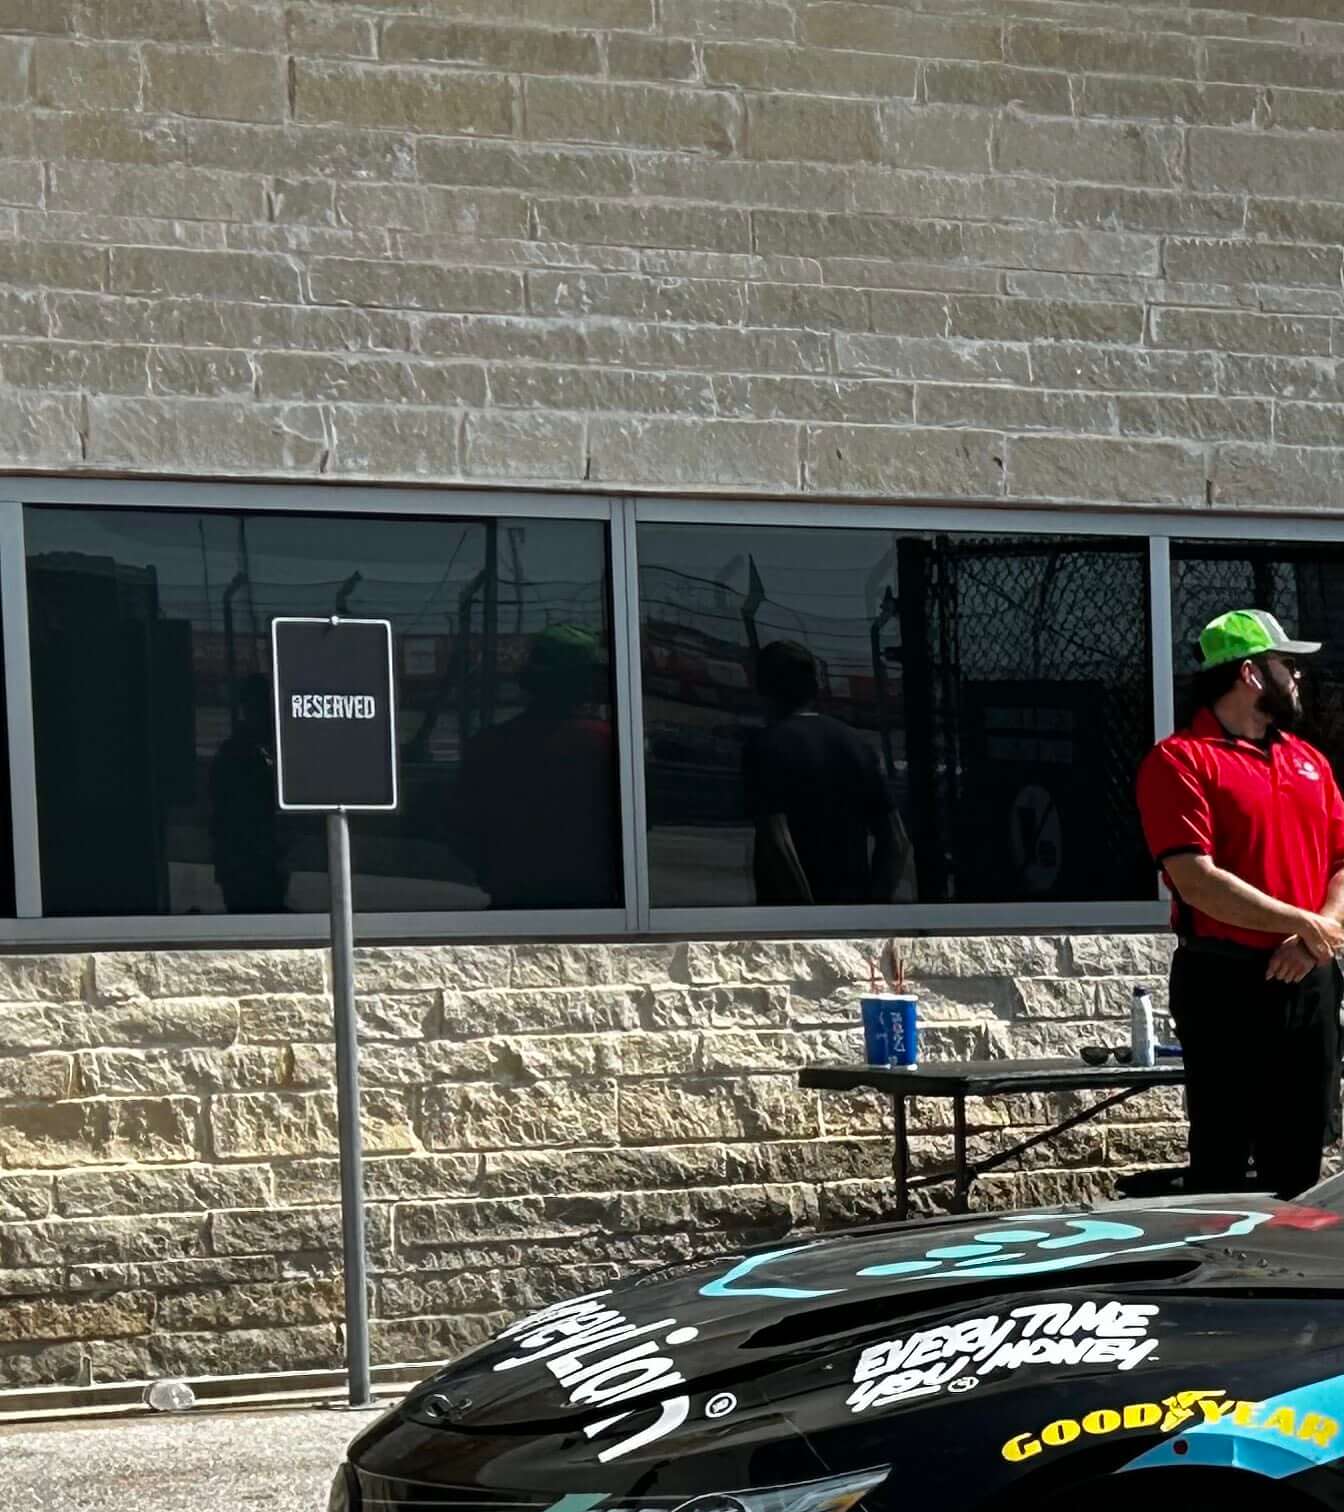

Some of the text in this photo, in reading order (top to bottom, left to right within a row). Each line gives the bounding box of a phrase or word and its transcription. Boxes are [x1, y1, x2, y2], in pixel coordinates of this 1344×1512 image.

[292, 695, 375, 719] RESERVED
[852, 1301, 1160, 1383] EVERY TIME
[1001, 1390, 1340, 1463] GOODYEAR
